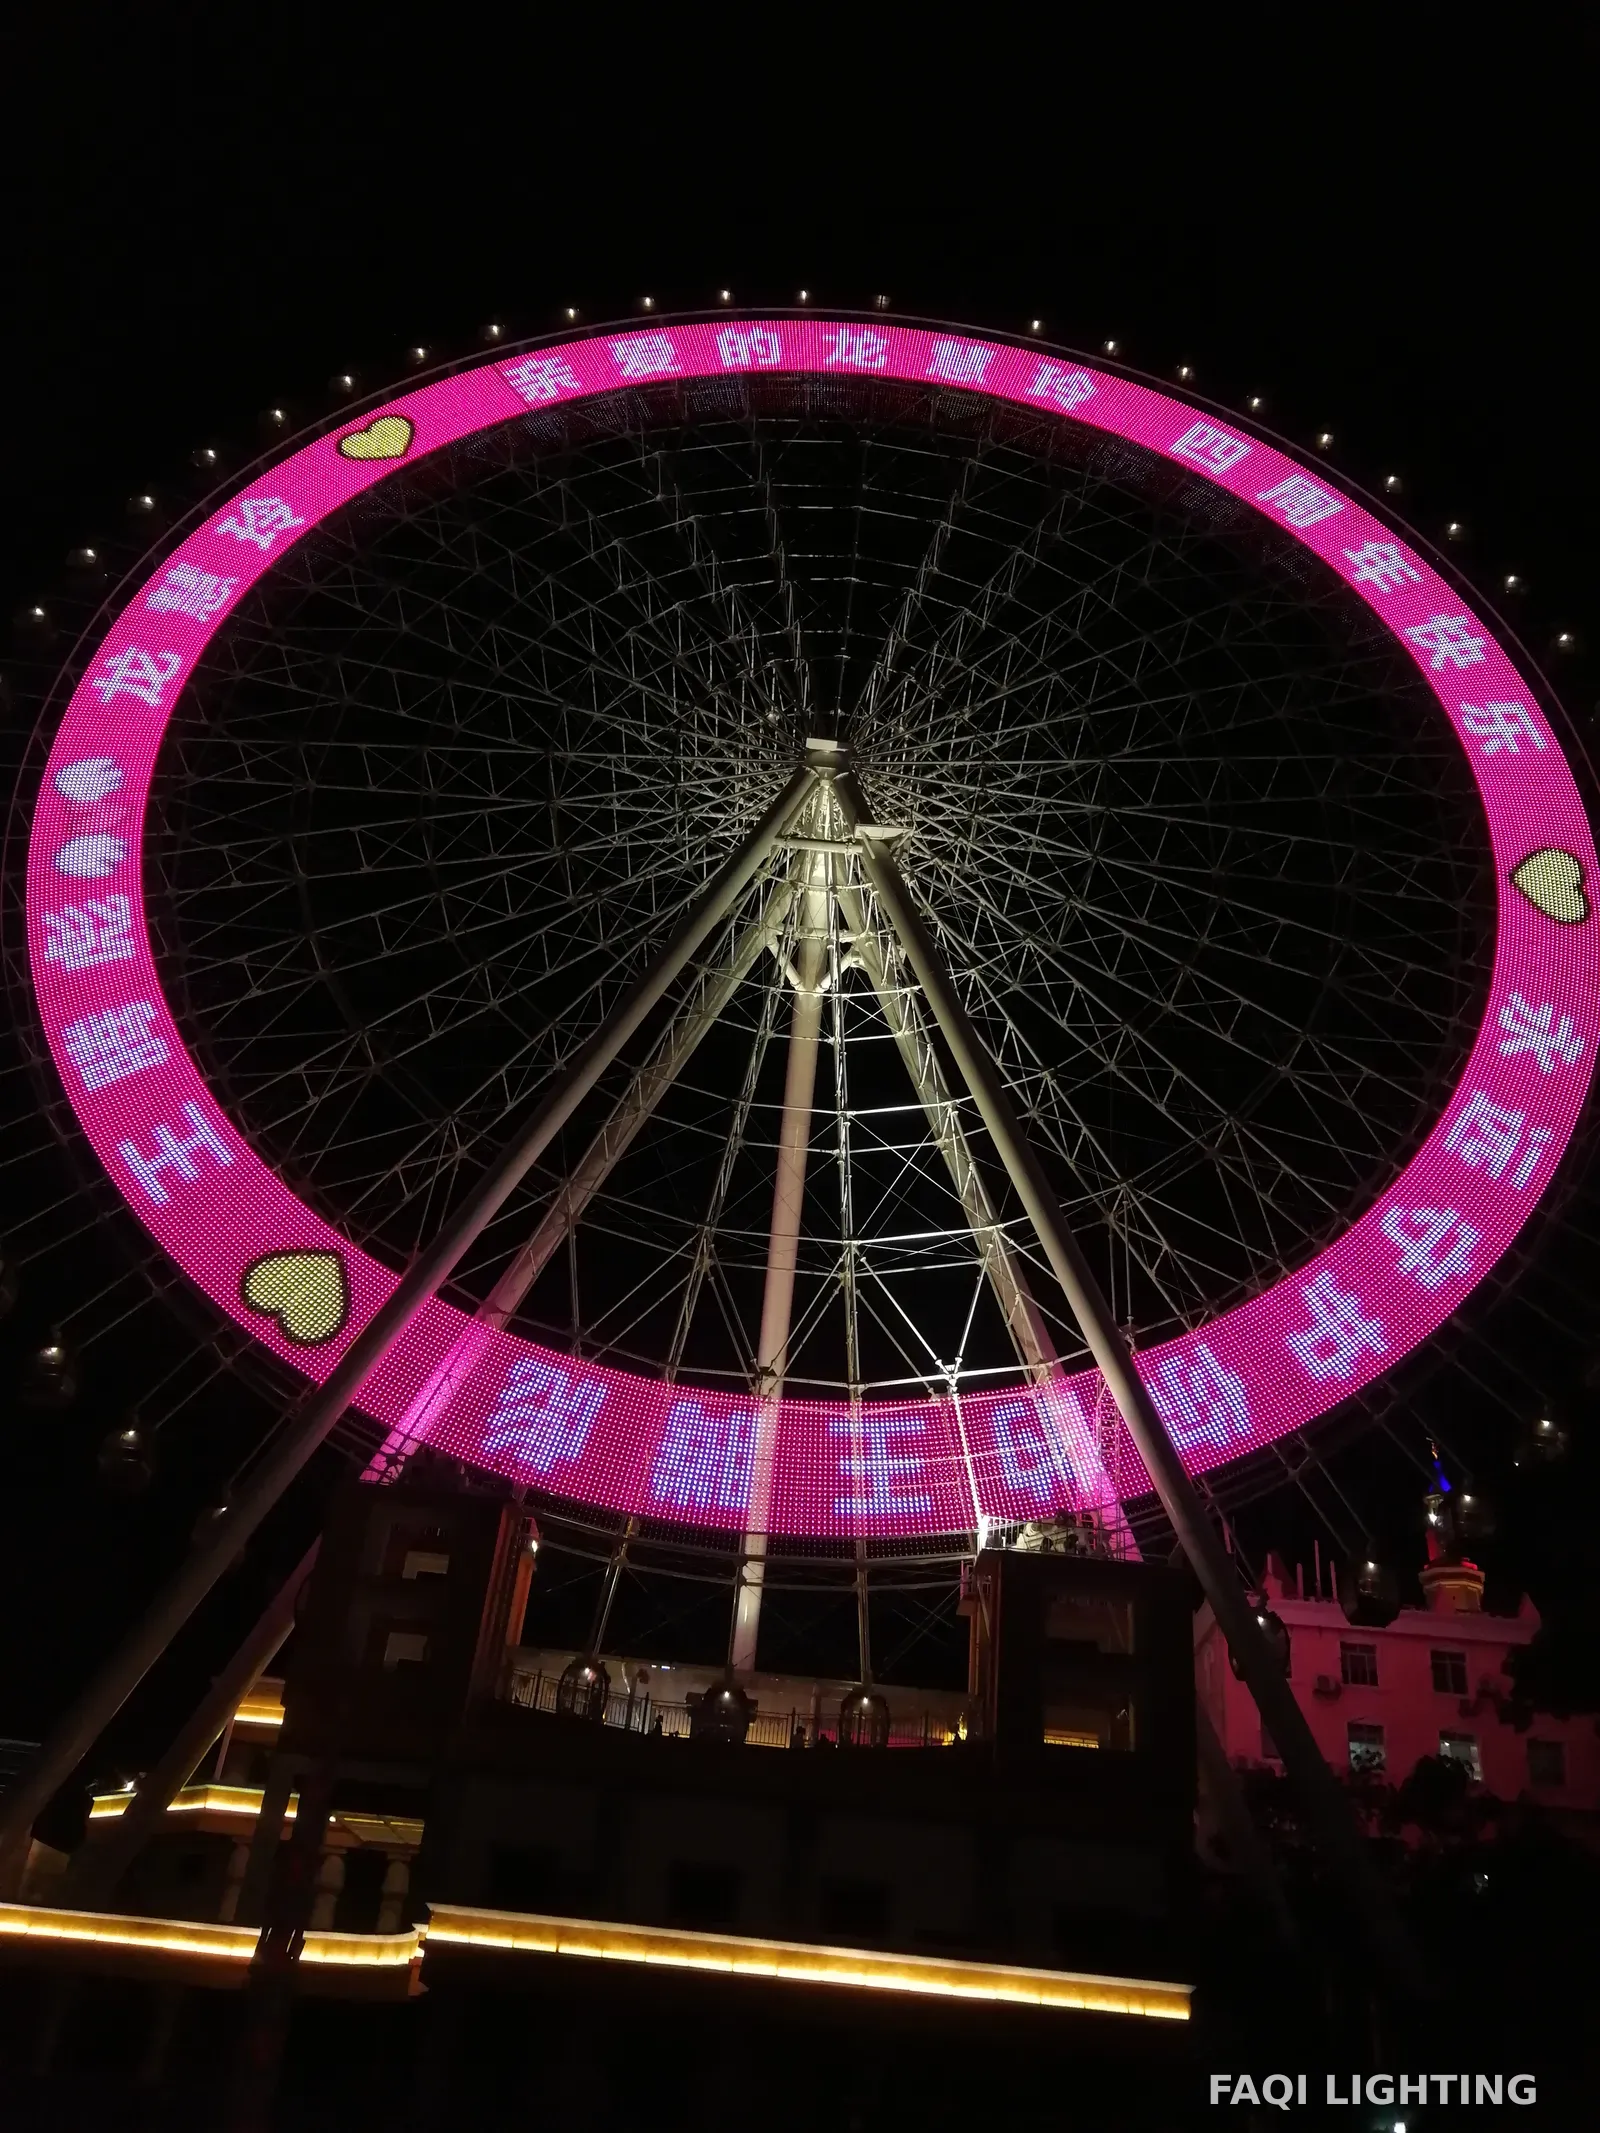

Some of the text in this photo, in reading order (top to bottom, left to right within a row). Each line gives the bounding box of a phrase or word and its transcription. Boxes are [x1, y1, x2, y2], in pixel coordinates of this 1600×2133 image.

[93, 497, 304, 706] 龙慧玲
[505, 327, 1547, 756] 亲爱的龙慧玲 四周年快乐
